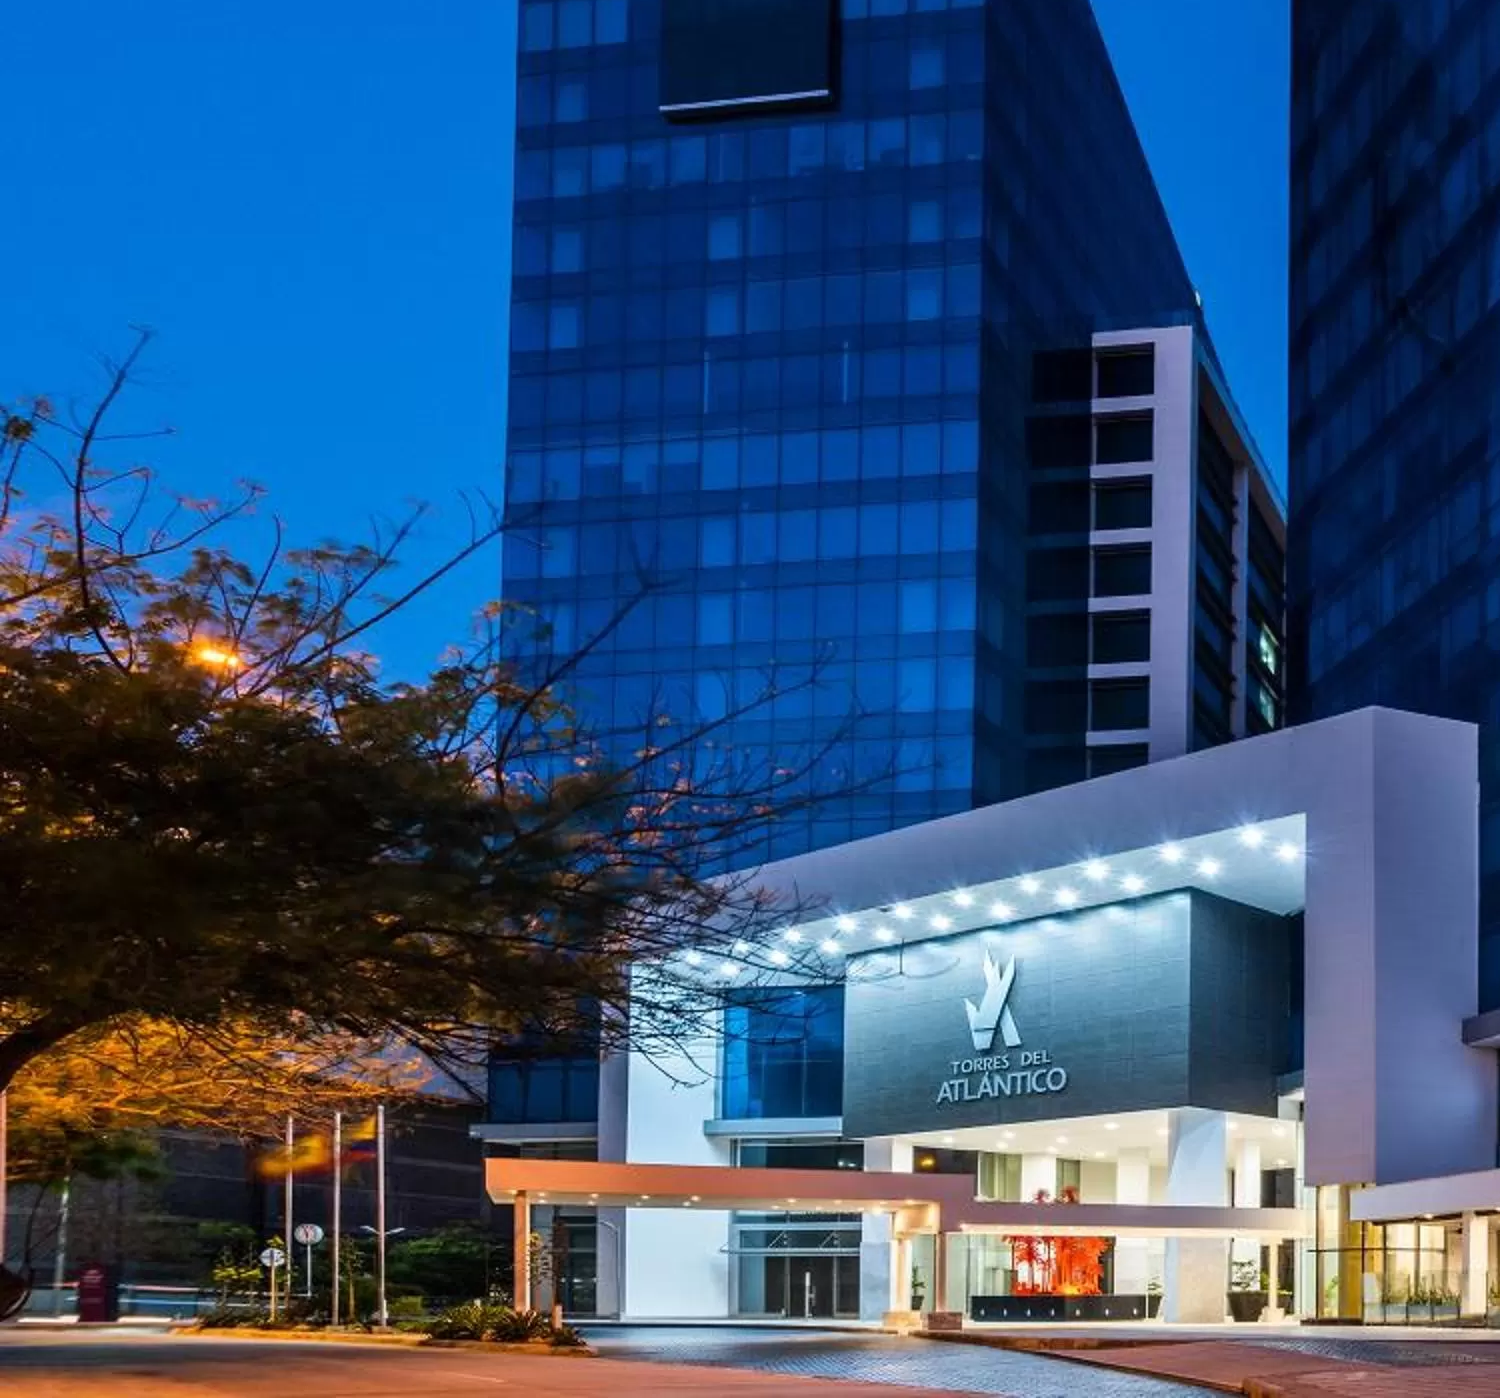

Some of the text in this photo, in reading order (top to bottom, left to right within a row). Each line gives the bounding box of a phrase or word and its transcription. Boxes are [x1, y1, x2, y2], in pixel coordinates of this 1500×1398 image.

[951, 1050, 1051, 1074] TORRES DEL
[936, 1068, 1067, 1104] ATLÁNTICO
